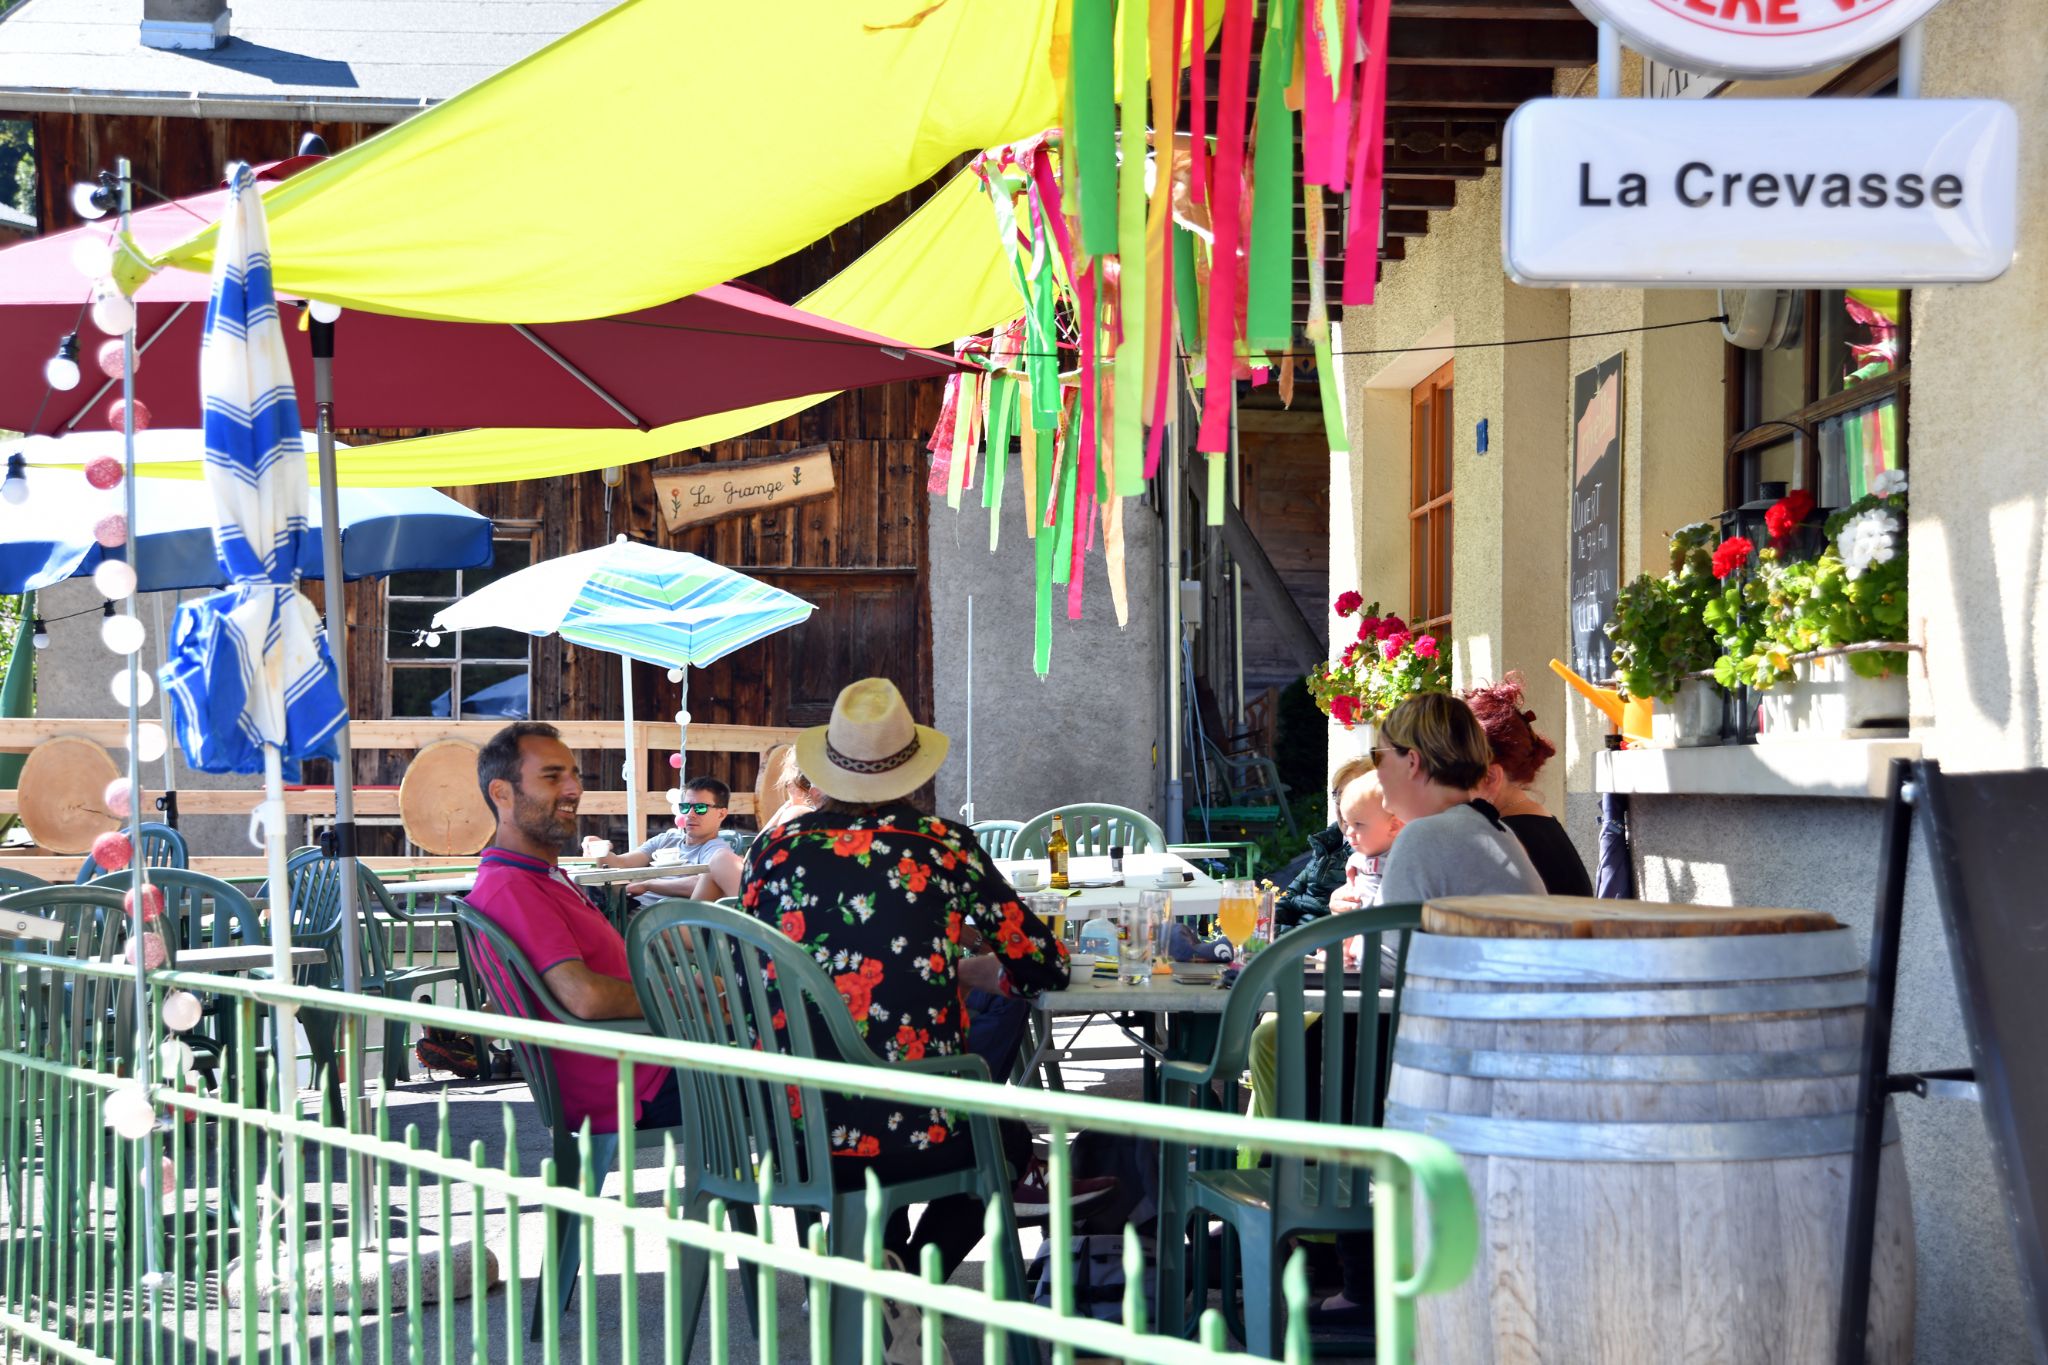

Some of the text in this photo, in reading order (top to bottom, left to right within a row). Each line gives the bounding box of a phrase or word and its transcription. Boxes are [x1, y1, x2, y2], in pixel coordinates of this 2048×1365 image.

[1579, 162, 1964, 209] La Crevasse
[690, 481, 784, 507] La Grange
[1573, 482, 1603, 533] OUVERT
